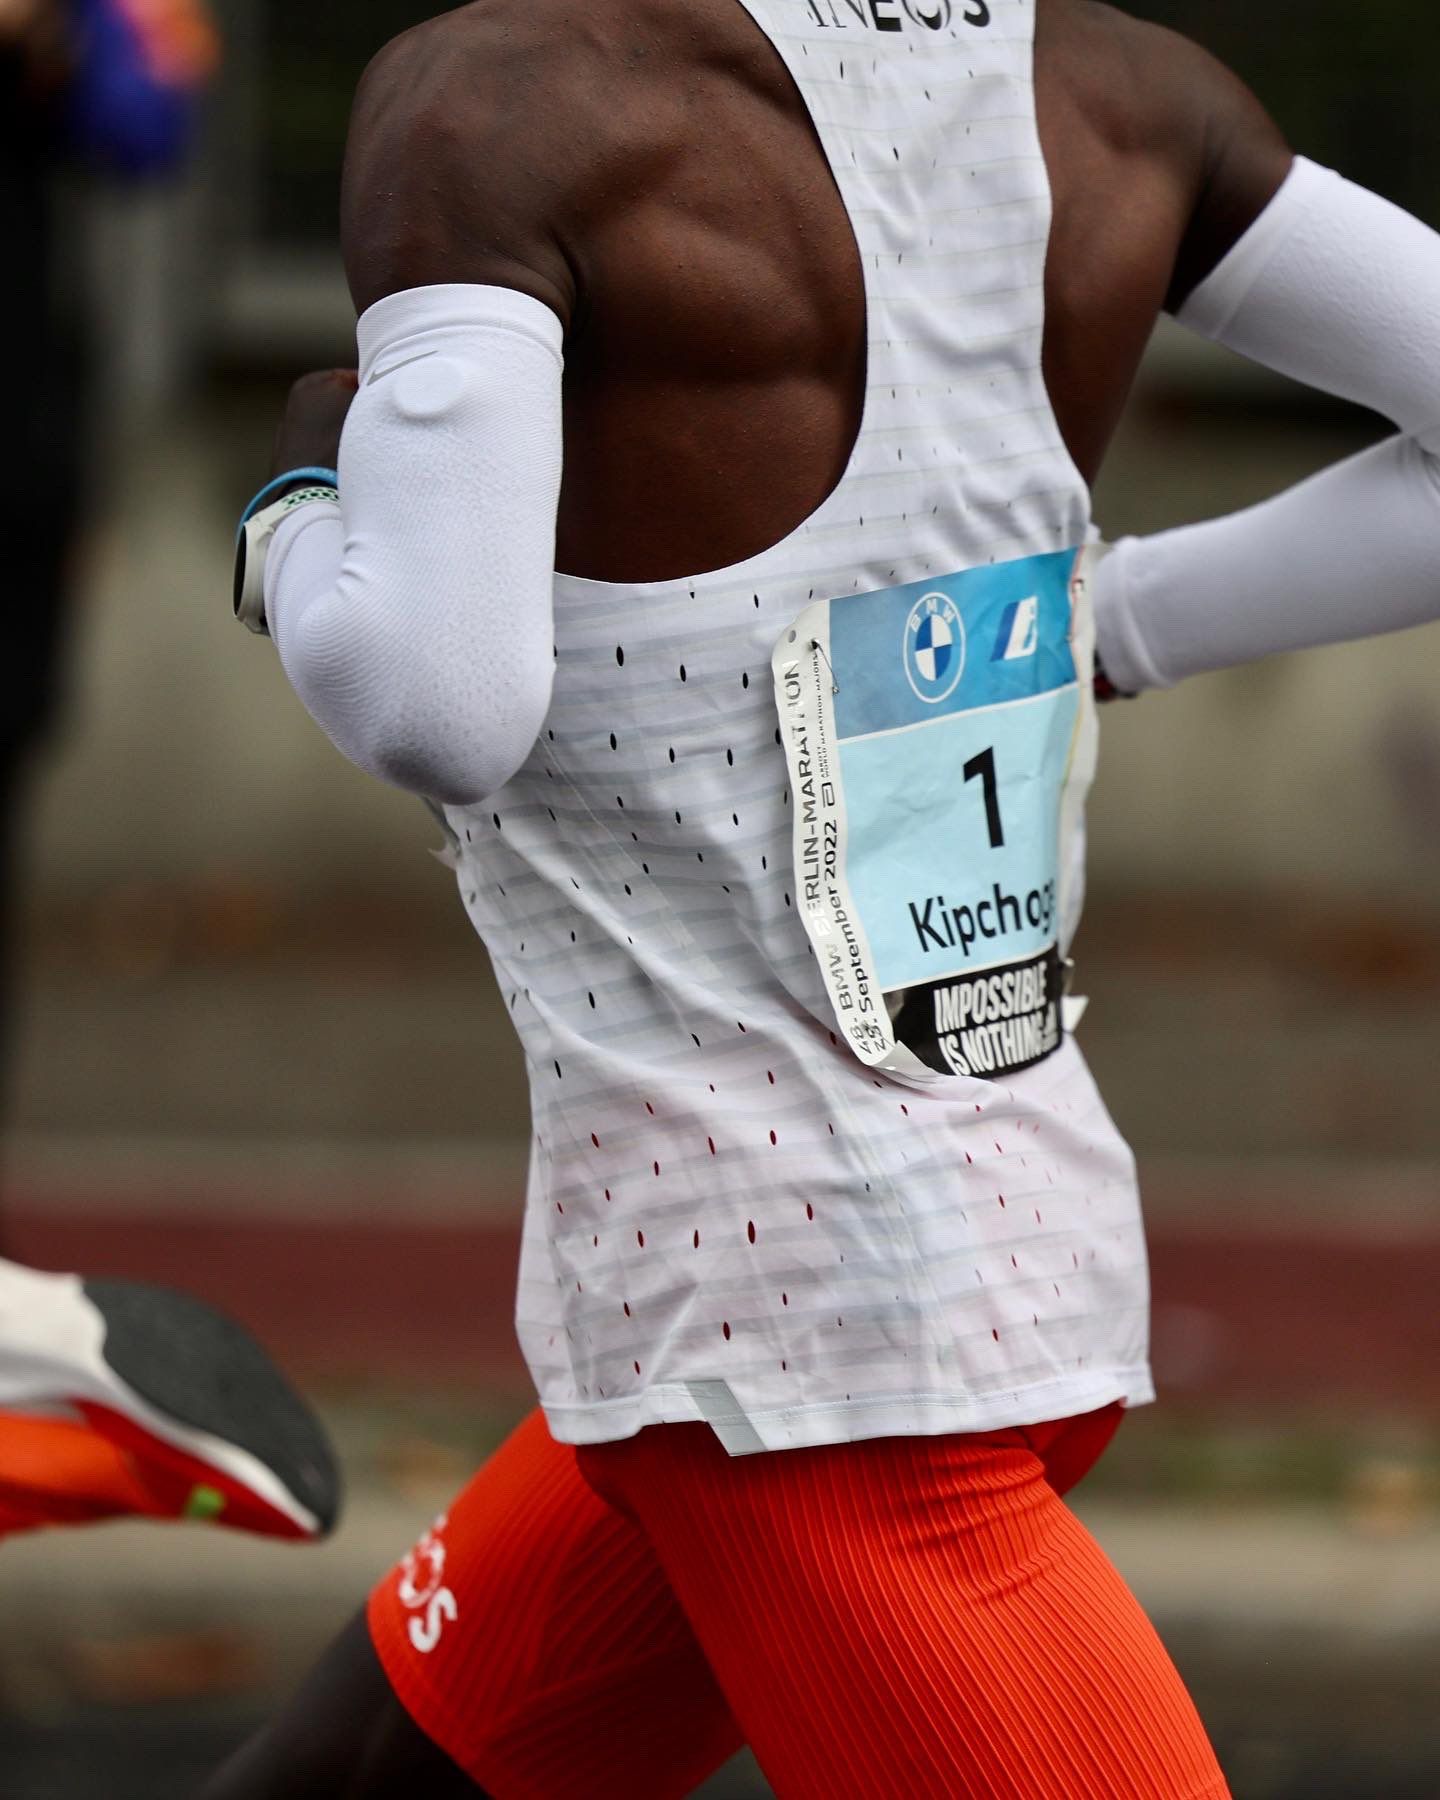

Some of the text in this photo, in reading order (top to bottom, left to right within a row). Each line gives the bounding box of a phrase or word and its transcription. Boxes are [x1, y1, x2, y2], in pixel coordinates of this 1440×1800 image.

[817, 695, 825, 744] MARATHON
[963, 746, 1005, 848] 1
[824, 820, 838, 881] 2022
[826, 944, 853, 1010] BMW
[828, 886, 873, 1013] September
[933, 961, 1047, 1034] IMPOSSIBLE
[938, 1034, 971, 1077] IS
